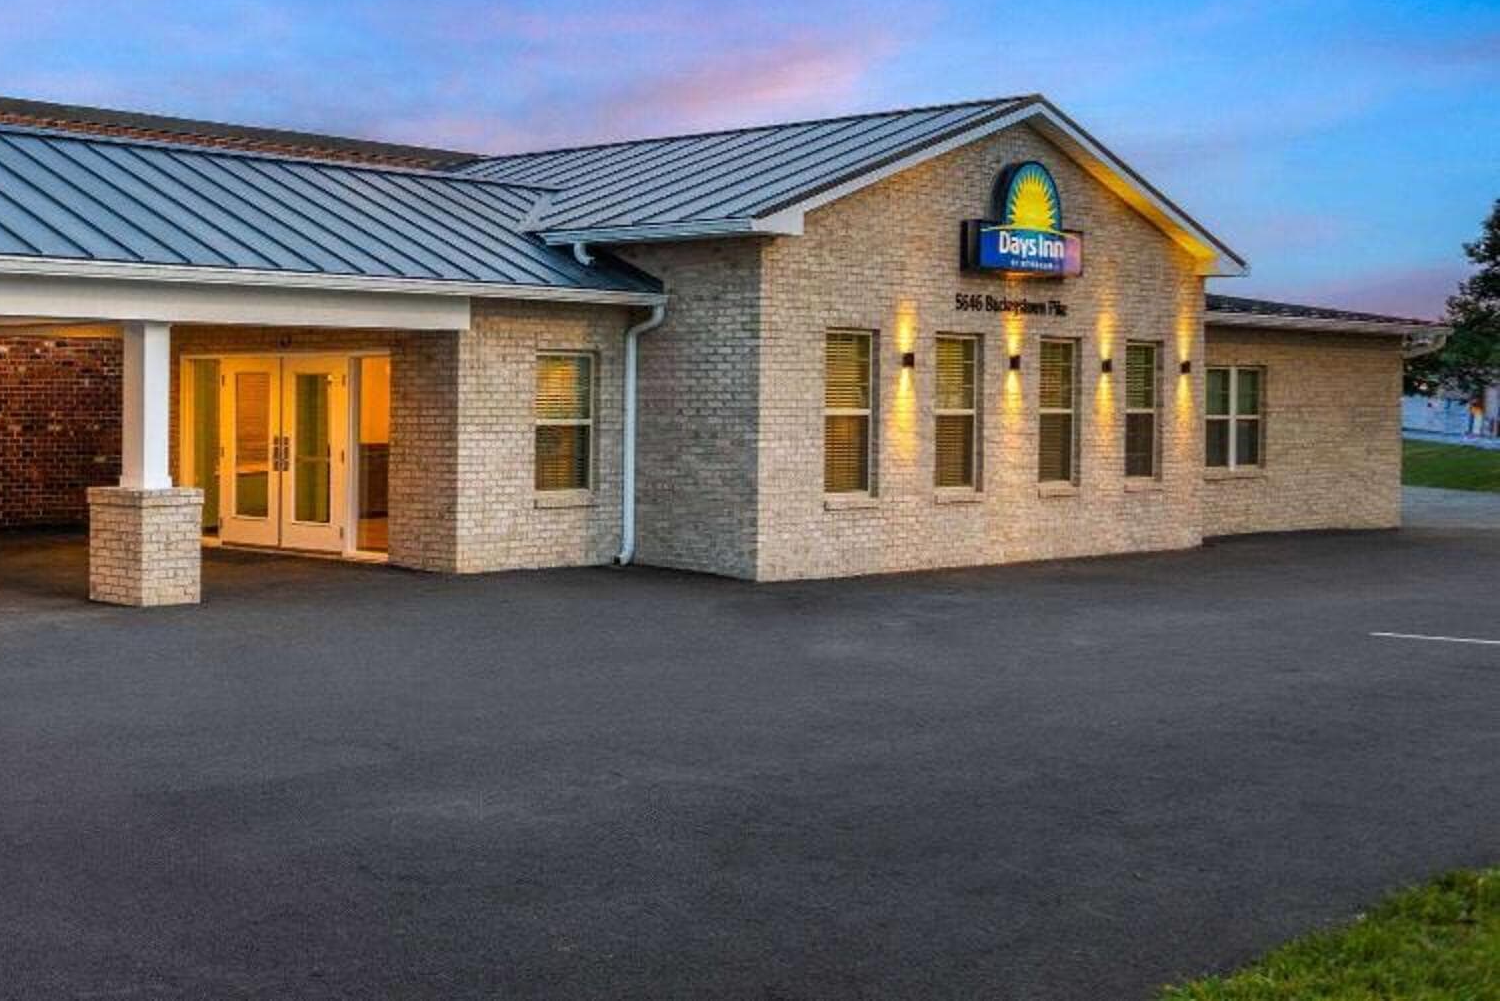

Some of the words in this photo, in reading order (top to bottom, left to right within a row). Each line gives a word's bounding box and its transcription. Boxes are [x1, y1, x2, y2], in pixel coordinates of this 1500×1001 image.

[999, 230, 1037, 258] Days
[1038, 234, 1064, 258] Inn
[955, 293, 983, 312] 5646
